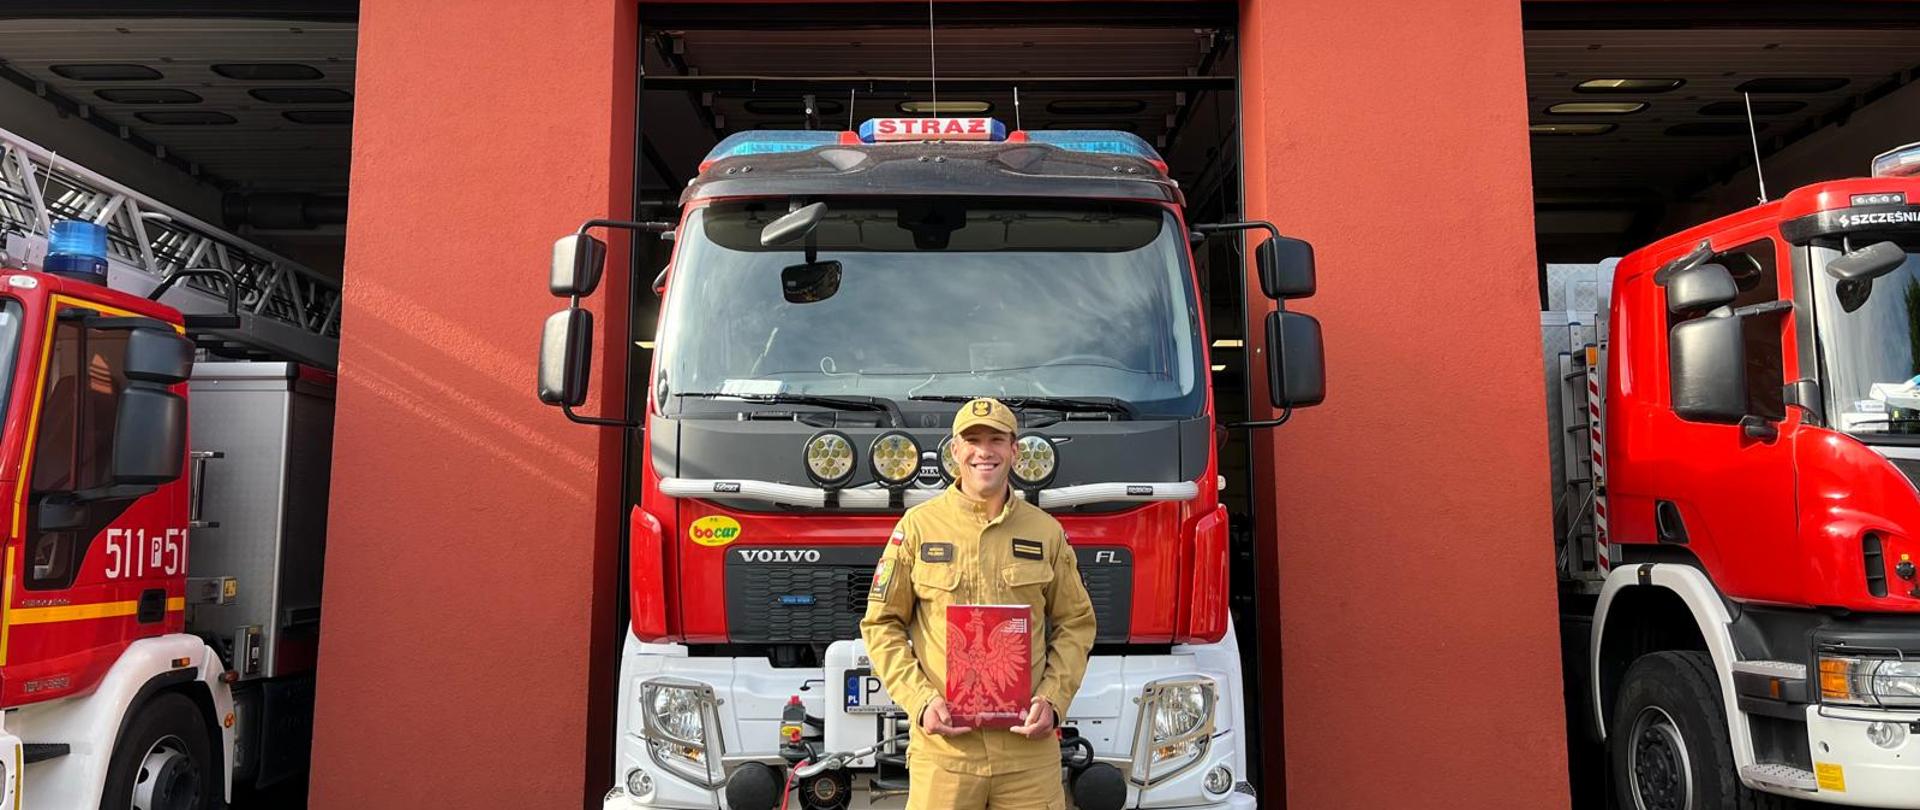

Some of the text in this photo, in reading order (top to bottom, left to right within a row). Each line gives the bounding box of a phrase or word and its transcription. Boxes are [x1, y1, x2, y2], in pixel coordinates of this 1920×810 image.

[878, 119, 986, 134] STRAŻ
[693, 525, 738, 539] bocar
[105, 528, 145, 578] 511
[165, 528, 187, 576] 51
[738, 550, 821, 563] VOLVO
[1095, 551, 1122, 564] FL
[848, 695, 858, 704] PL
